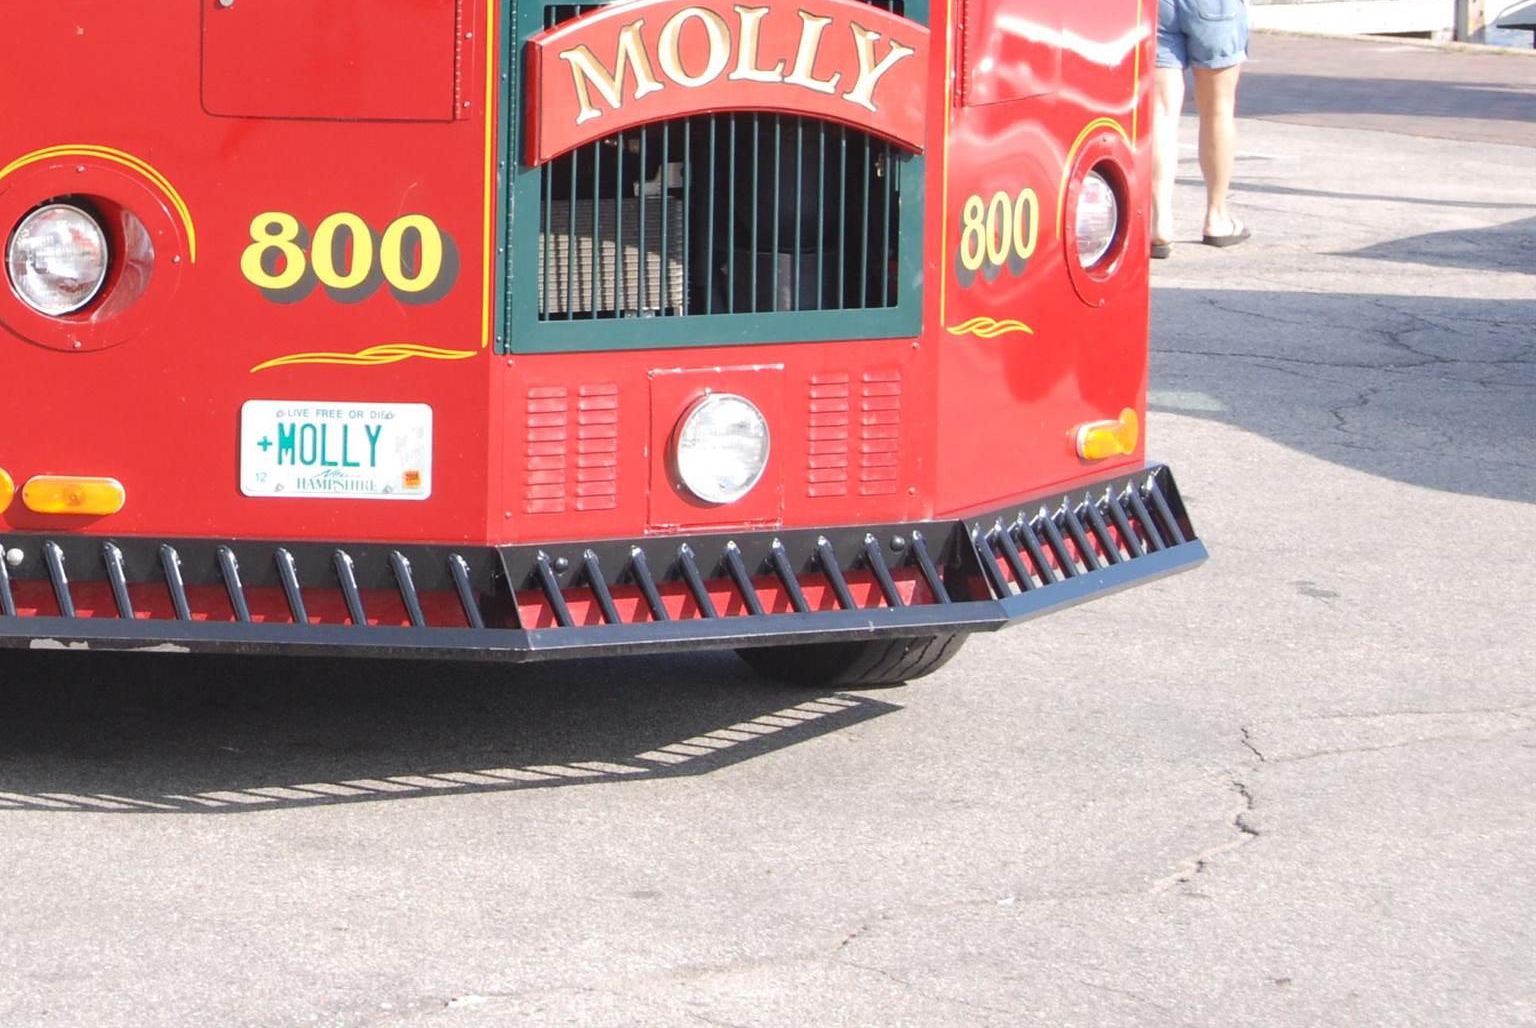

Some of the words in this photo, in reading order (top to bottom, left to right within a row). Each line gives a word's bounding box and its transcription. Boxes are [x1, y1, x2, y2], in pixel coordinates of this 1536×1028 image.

[558, 3, 916, 126] MOLLY
[240, 210, 449, 297] 800
[959, 186, 1040, 272] 800
[287, 408, 310, 419] LIVE
[315, 408, 343, 419] FREE
[348, 409, 364, 420] OR
[296, 476, 378, 493] HAMPSHIRE
